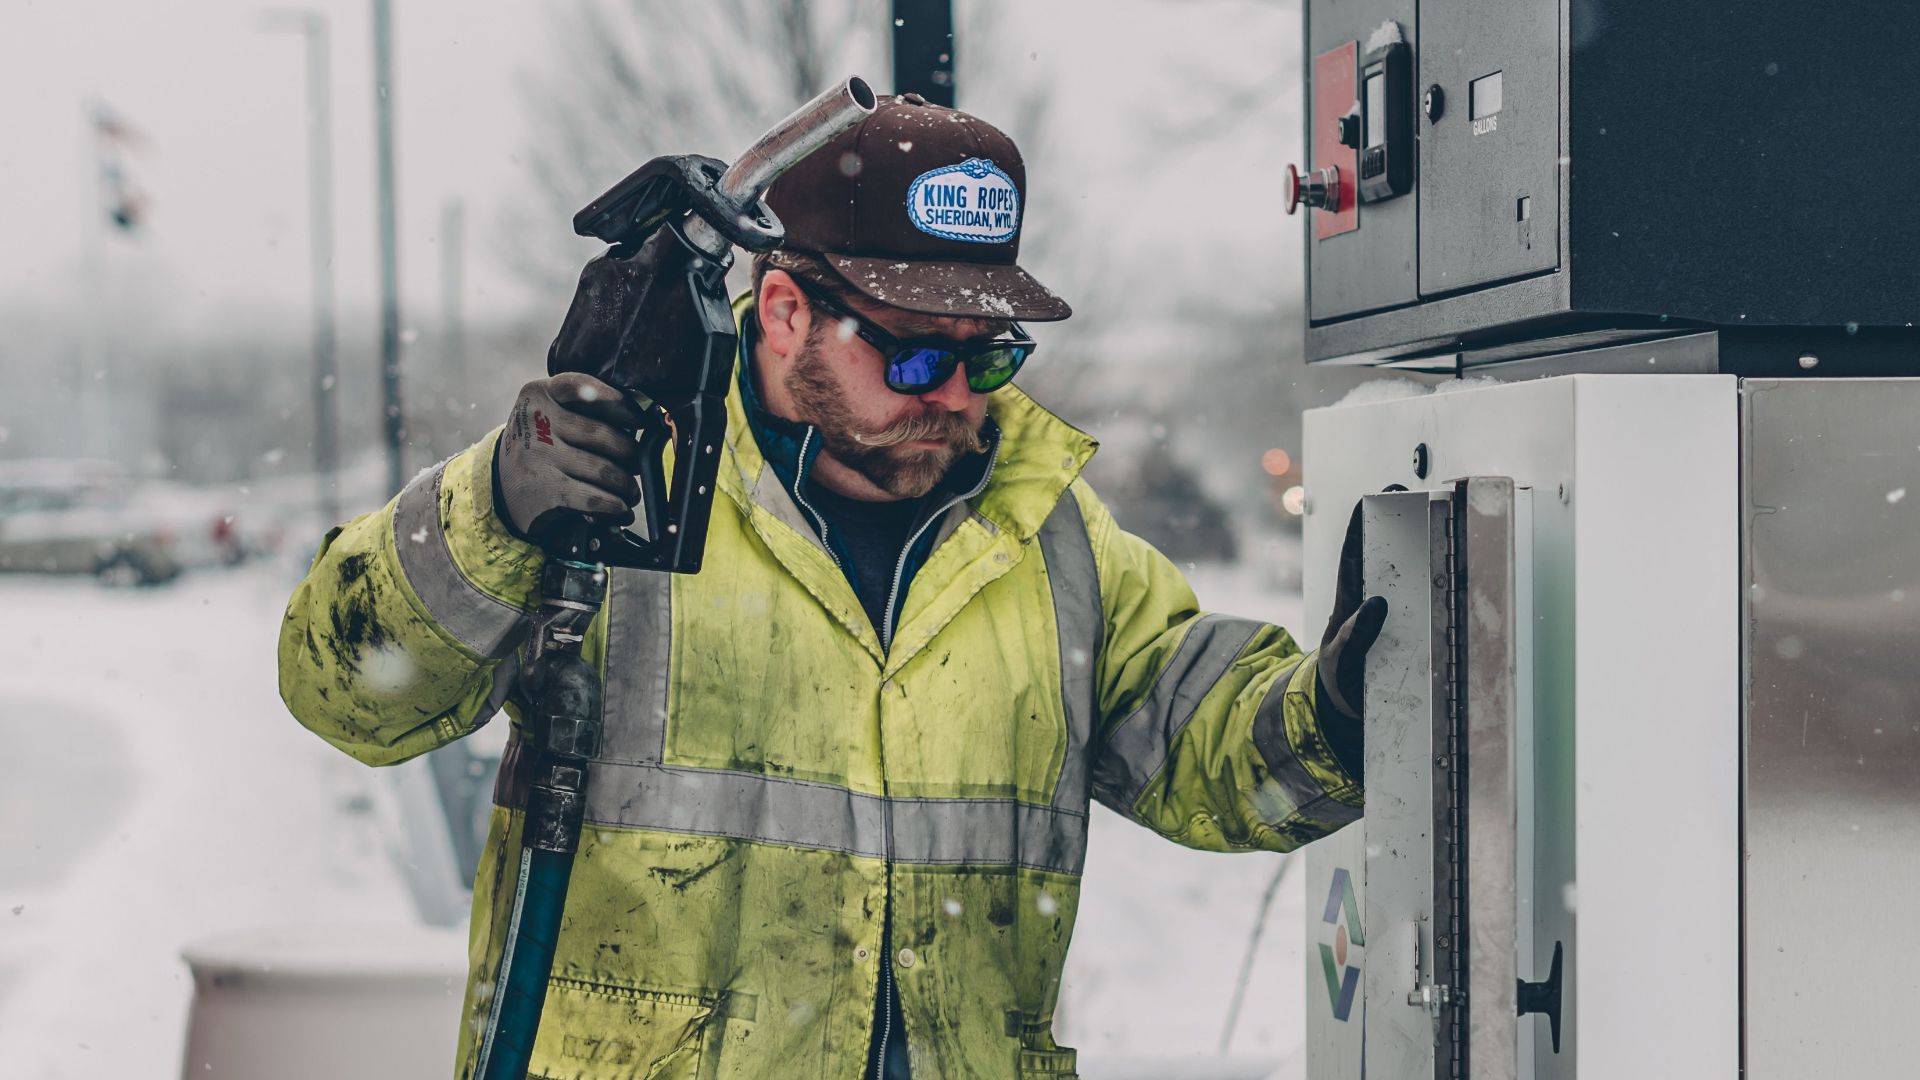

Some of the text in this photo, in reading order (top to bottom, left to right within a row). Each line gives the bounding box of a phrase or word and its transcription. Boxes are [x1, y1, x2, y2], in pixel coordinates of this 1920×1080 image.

[1473, 115, 1497, 136] GALLONS
[924, 183, 1013, 211] KING ROPES
[925, 208, 1014, 231] SHERIDAN, WYO.
[521, 397, 530, 430] Comfort
[534, 410, 554, 446] 3M
